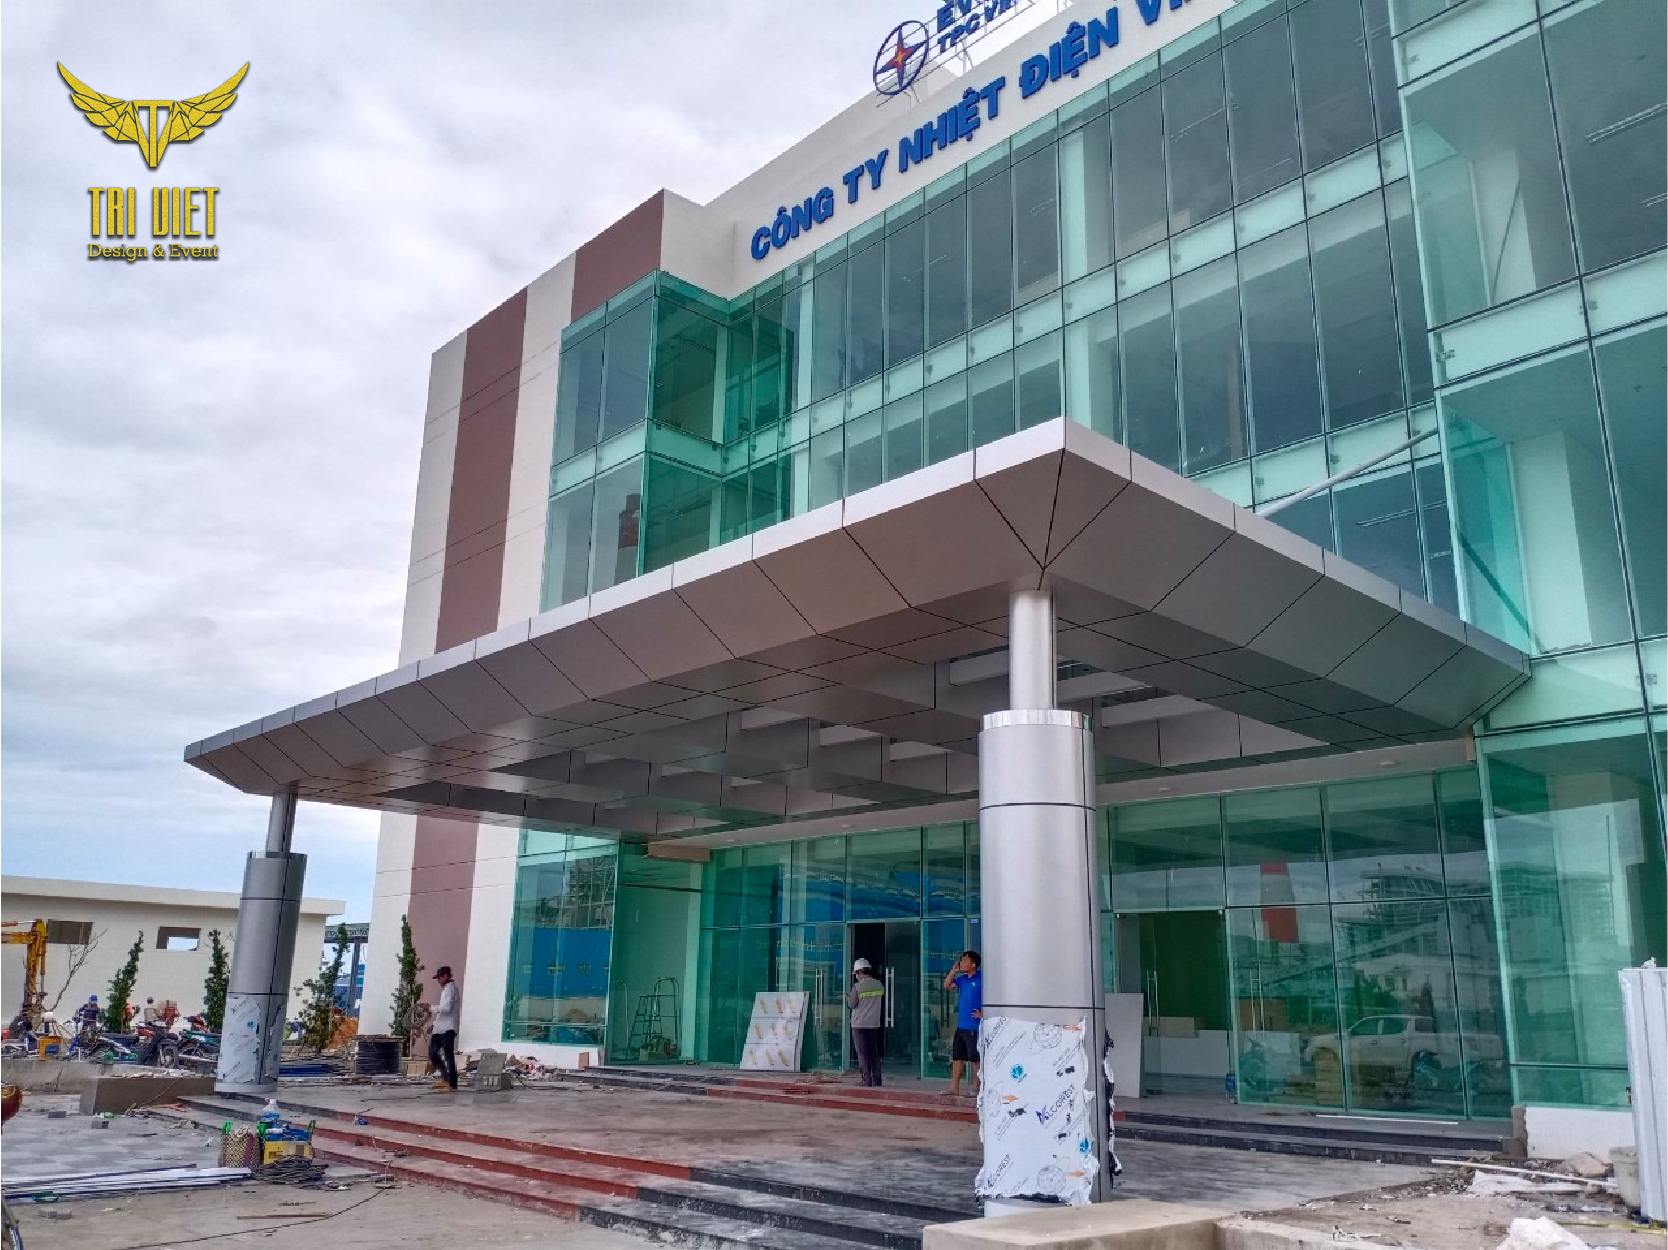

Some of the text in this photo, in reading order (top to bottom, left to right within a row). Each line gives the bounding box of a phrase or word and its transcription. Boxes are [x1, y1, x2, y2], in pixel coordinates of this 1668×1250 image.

[938, 13, 981, 55] TPC
[751, 186, 834, 260] CÔNG
[843, 148, 888, 203] TY
[899, 76, 1005, 173] NHIỆT
[1019, 6, 1119, 99] ĐIỆN
